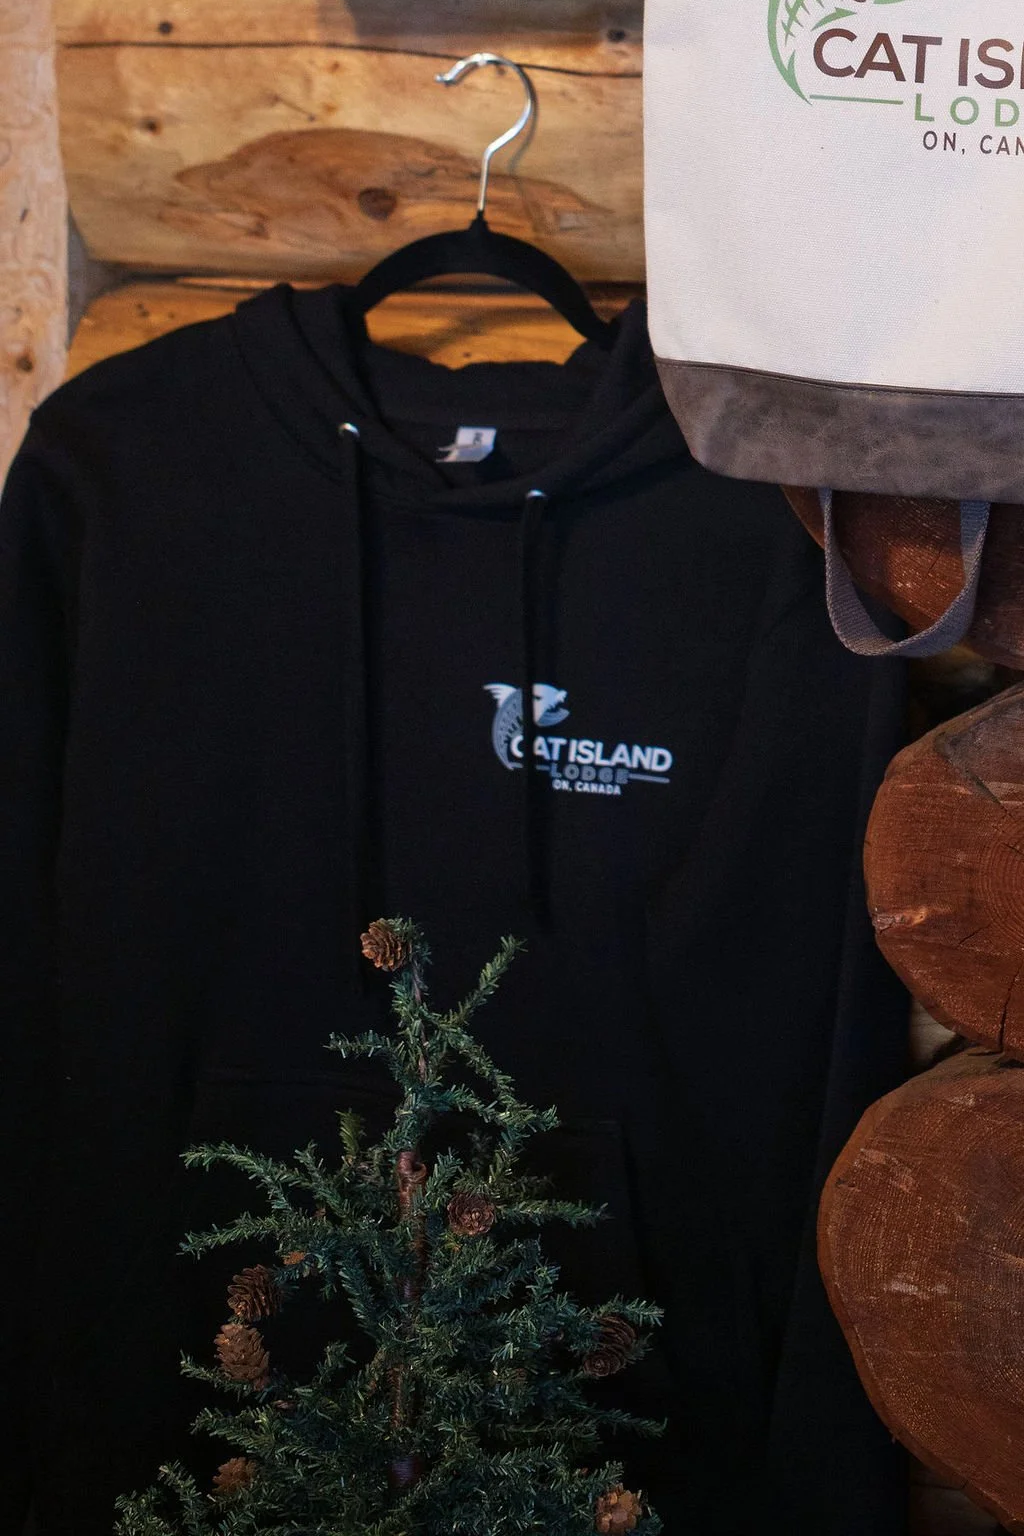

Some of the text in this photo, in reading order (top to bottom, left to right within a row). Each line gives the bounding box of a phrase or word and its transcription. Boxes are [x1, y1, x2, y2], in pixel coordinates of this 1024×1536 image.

[812, 27, 943, 84] CAT
[922, 130, 966, 155] ON,
[510, 734, 673, 773] CAT ISLAND
[550, 762, 629, 784] LODGE
[574, 780, 622, 796] CANADA
